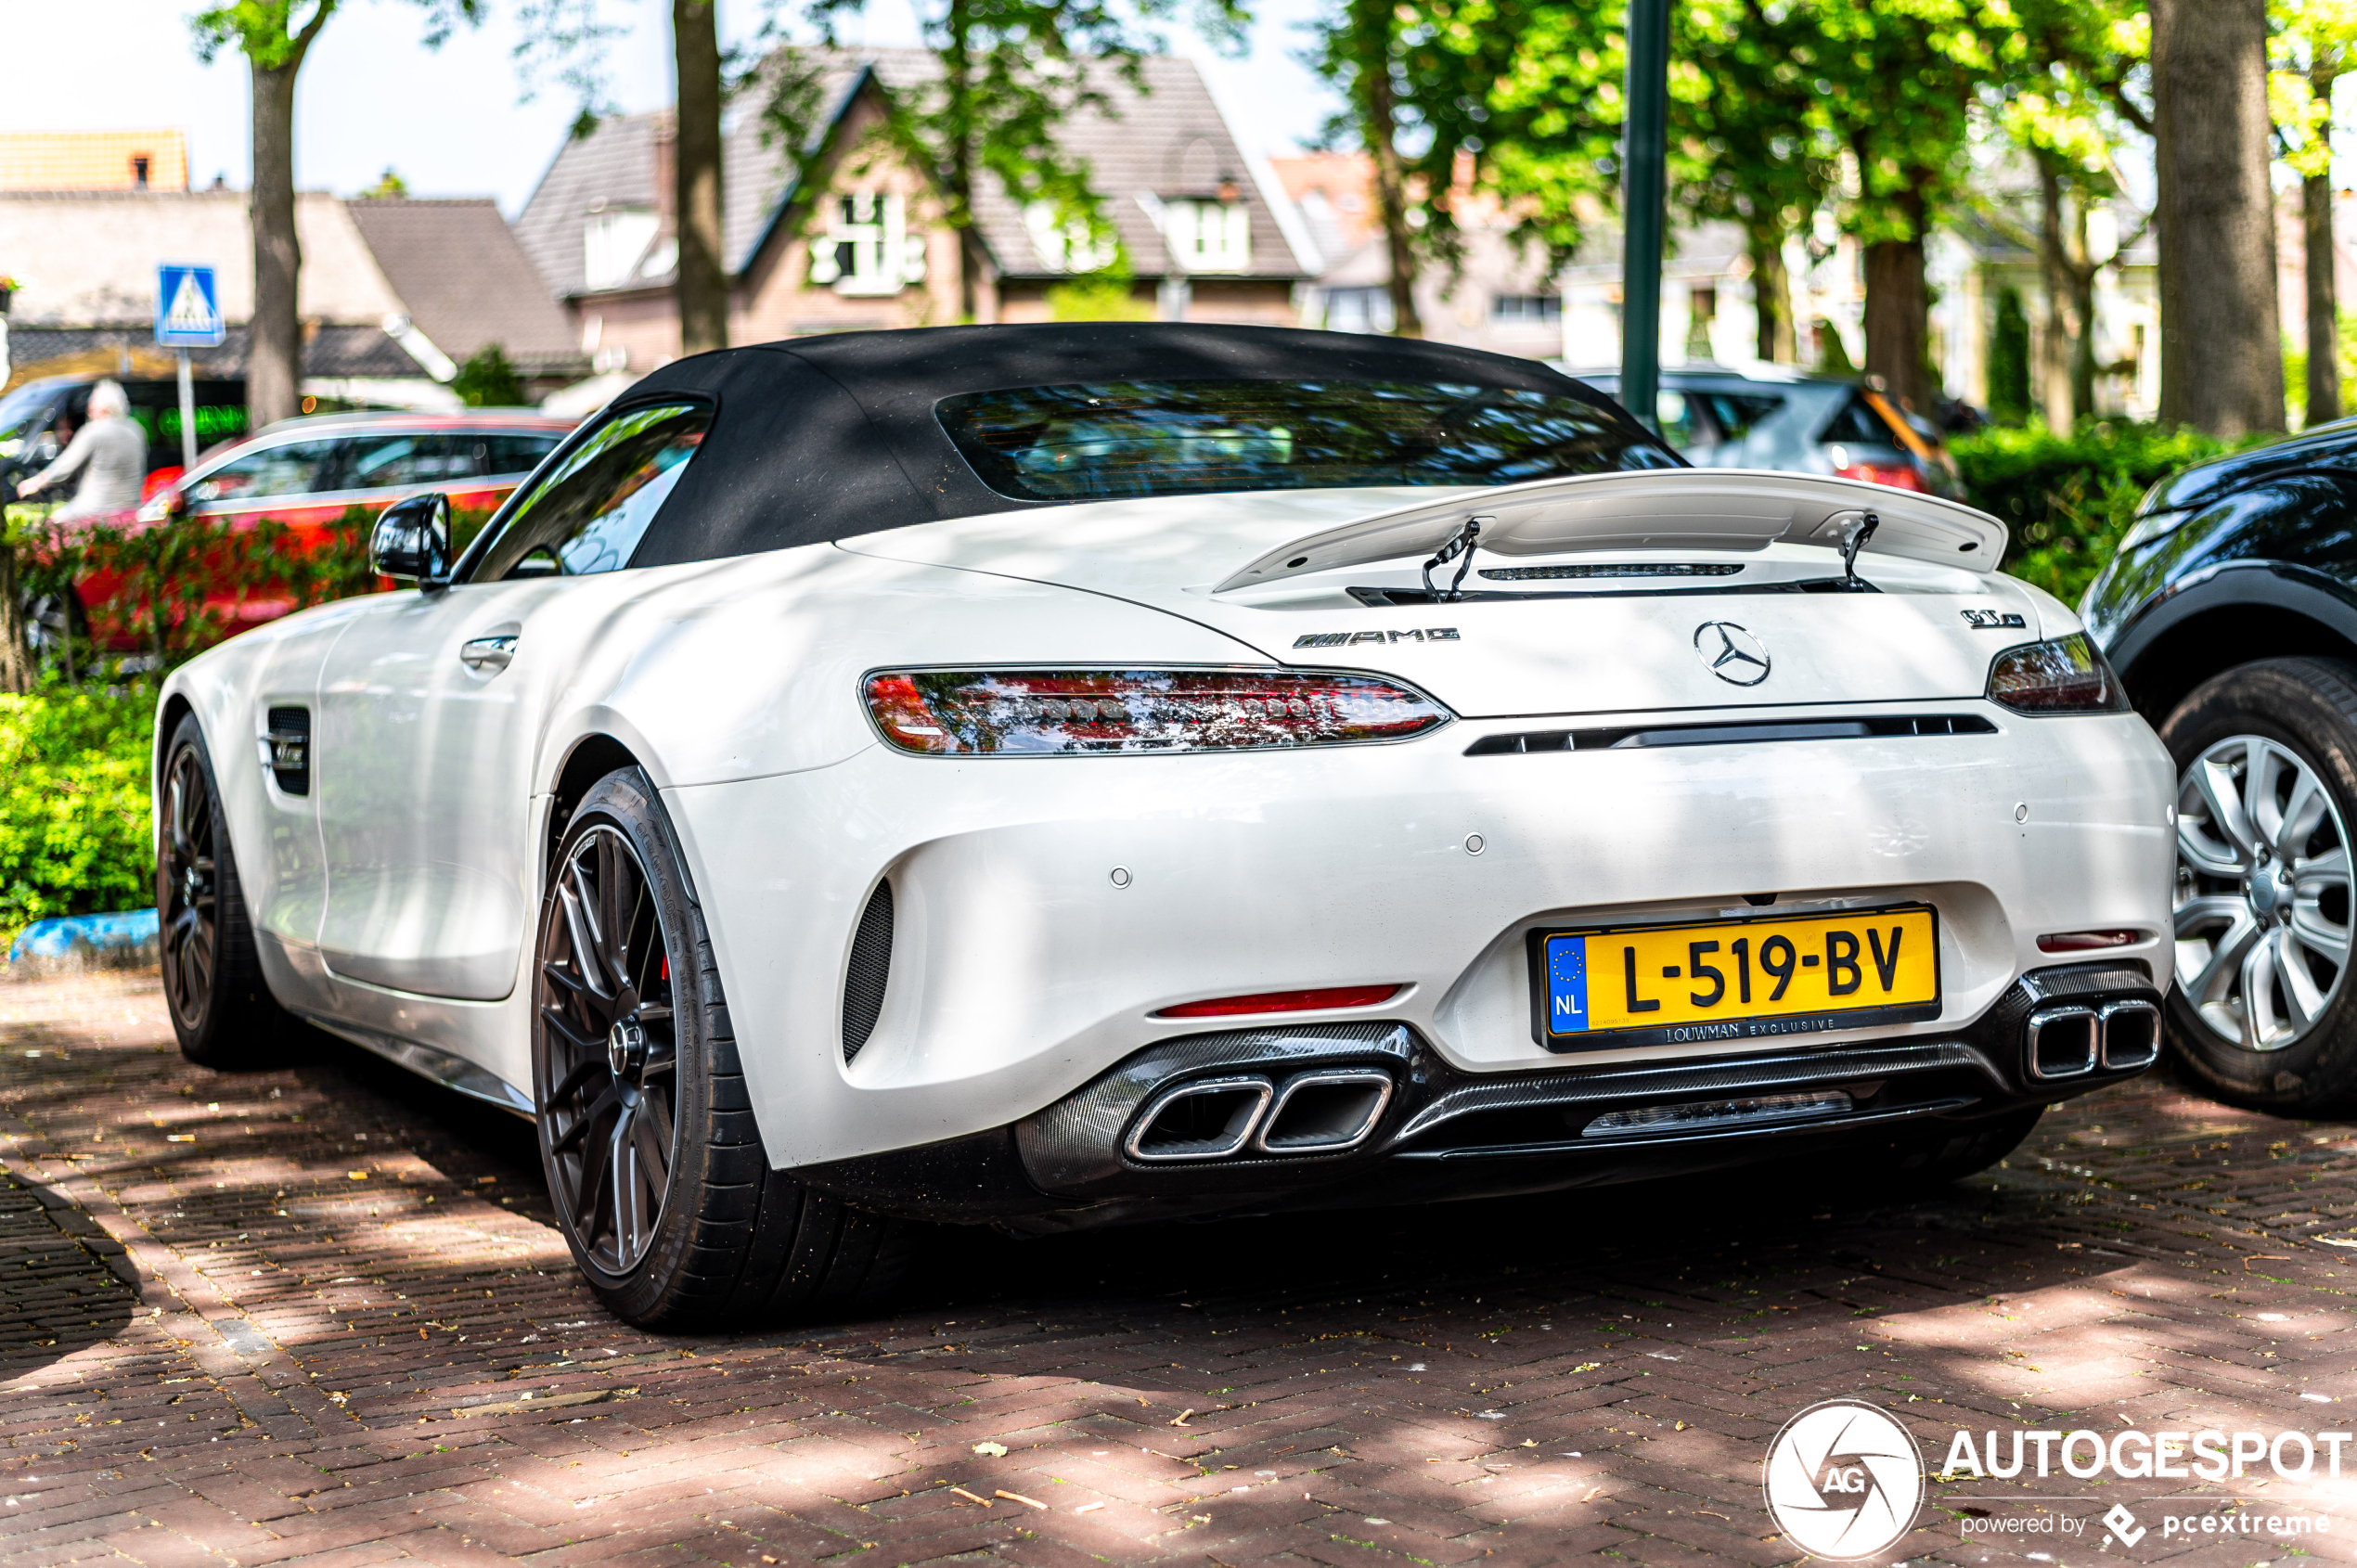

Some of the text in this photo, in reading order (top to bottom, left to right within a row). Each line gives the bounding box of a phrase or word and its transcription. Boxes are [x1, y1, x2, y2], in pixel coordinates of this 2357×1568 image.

[1347, 627, 1461, 647] AMG
[1624, 926, 1903, 1013] L-519-BV
[1556, 996, 1582, 1015] NL
[1666, 1019, 1835, 1043] LOUWMAN EXCLUSIVE
